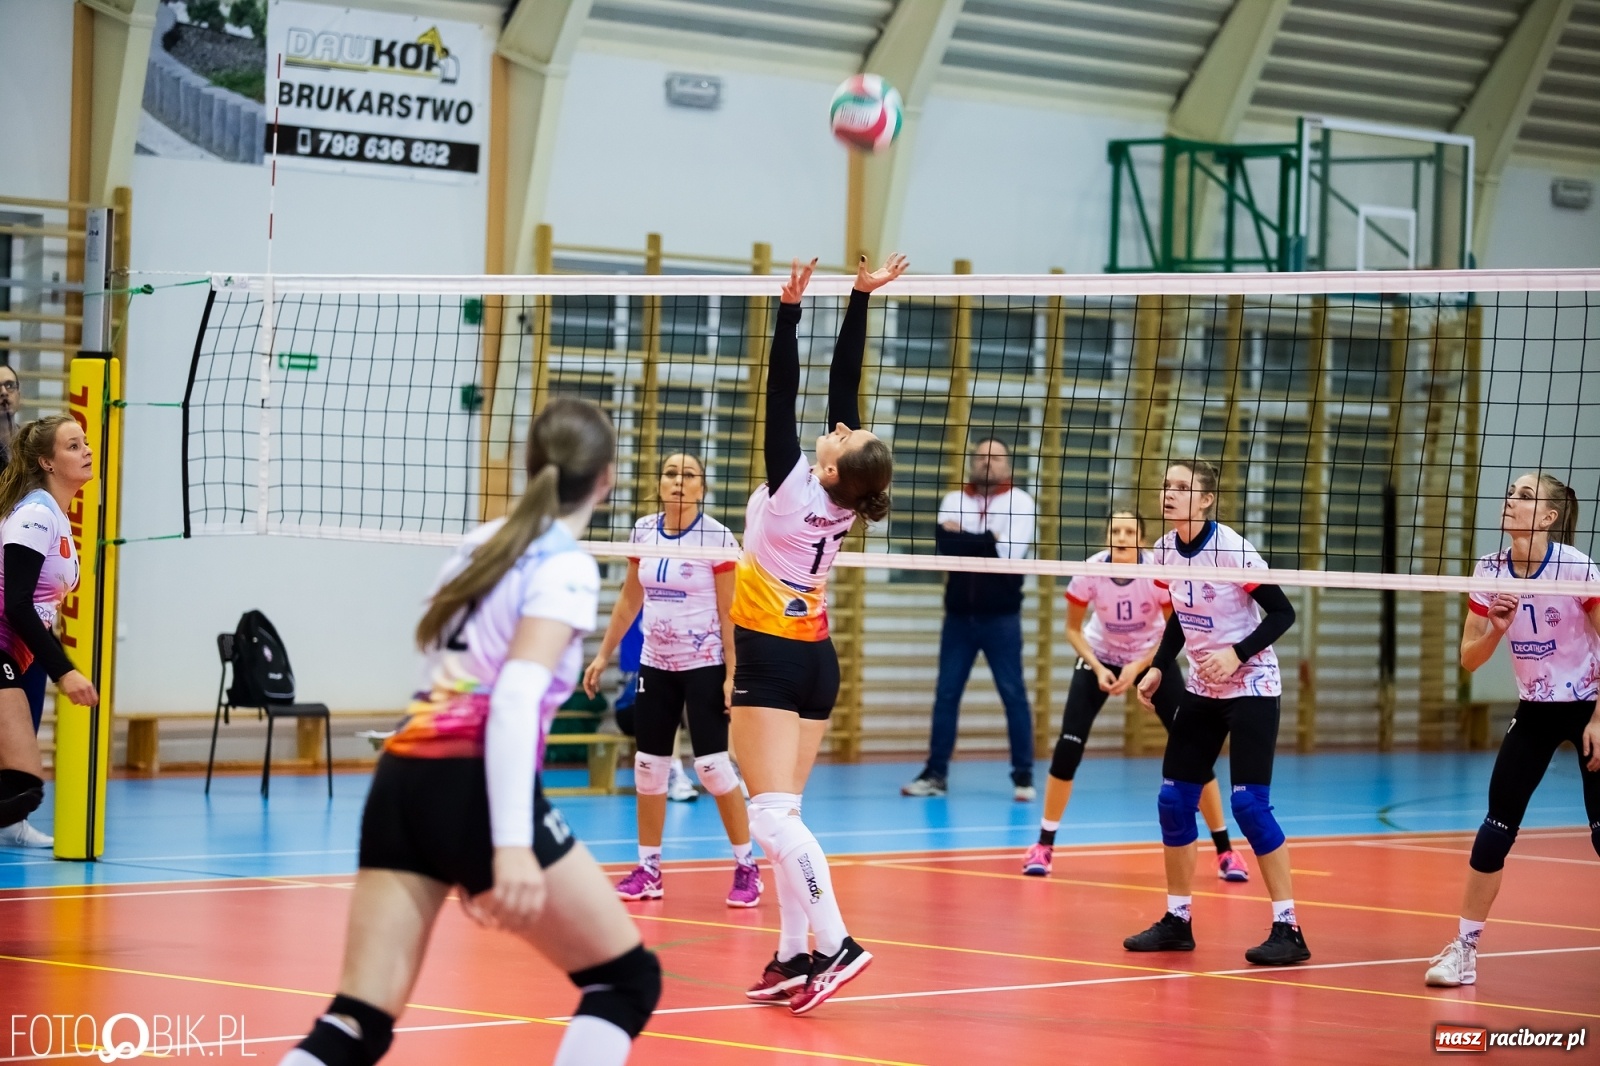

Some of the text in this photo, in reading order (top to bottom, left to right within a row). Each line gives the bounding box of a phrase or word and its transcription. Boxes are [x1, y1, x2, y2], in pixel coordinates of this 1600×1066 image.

[278, 81, 474, 126] BRUKARSTWO
[317, 133, 451, 167] 798 636 882
[656, 558, 670, 583] 11
[1184, 580, 1194, 608] 3
[1116, 597, 1133, 621] 13
[1522, 604, 1538, 634] 7
[1513, 641, 1553, 654] DECATHLON
[2, 663, 15, 681] 9
